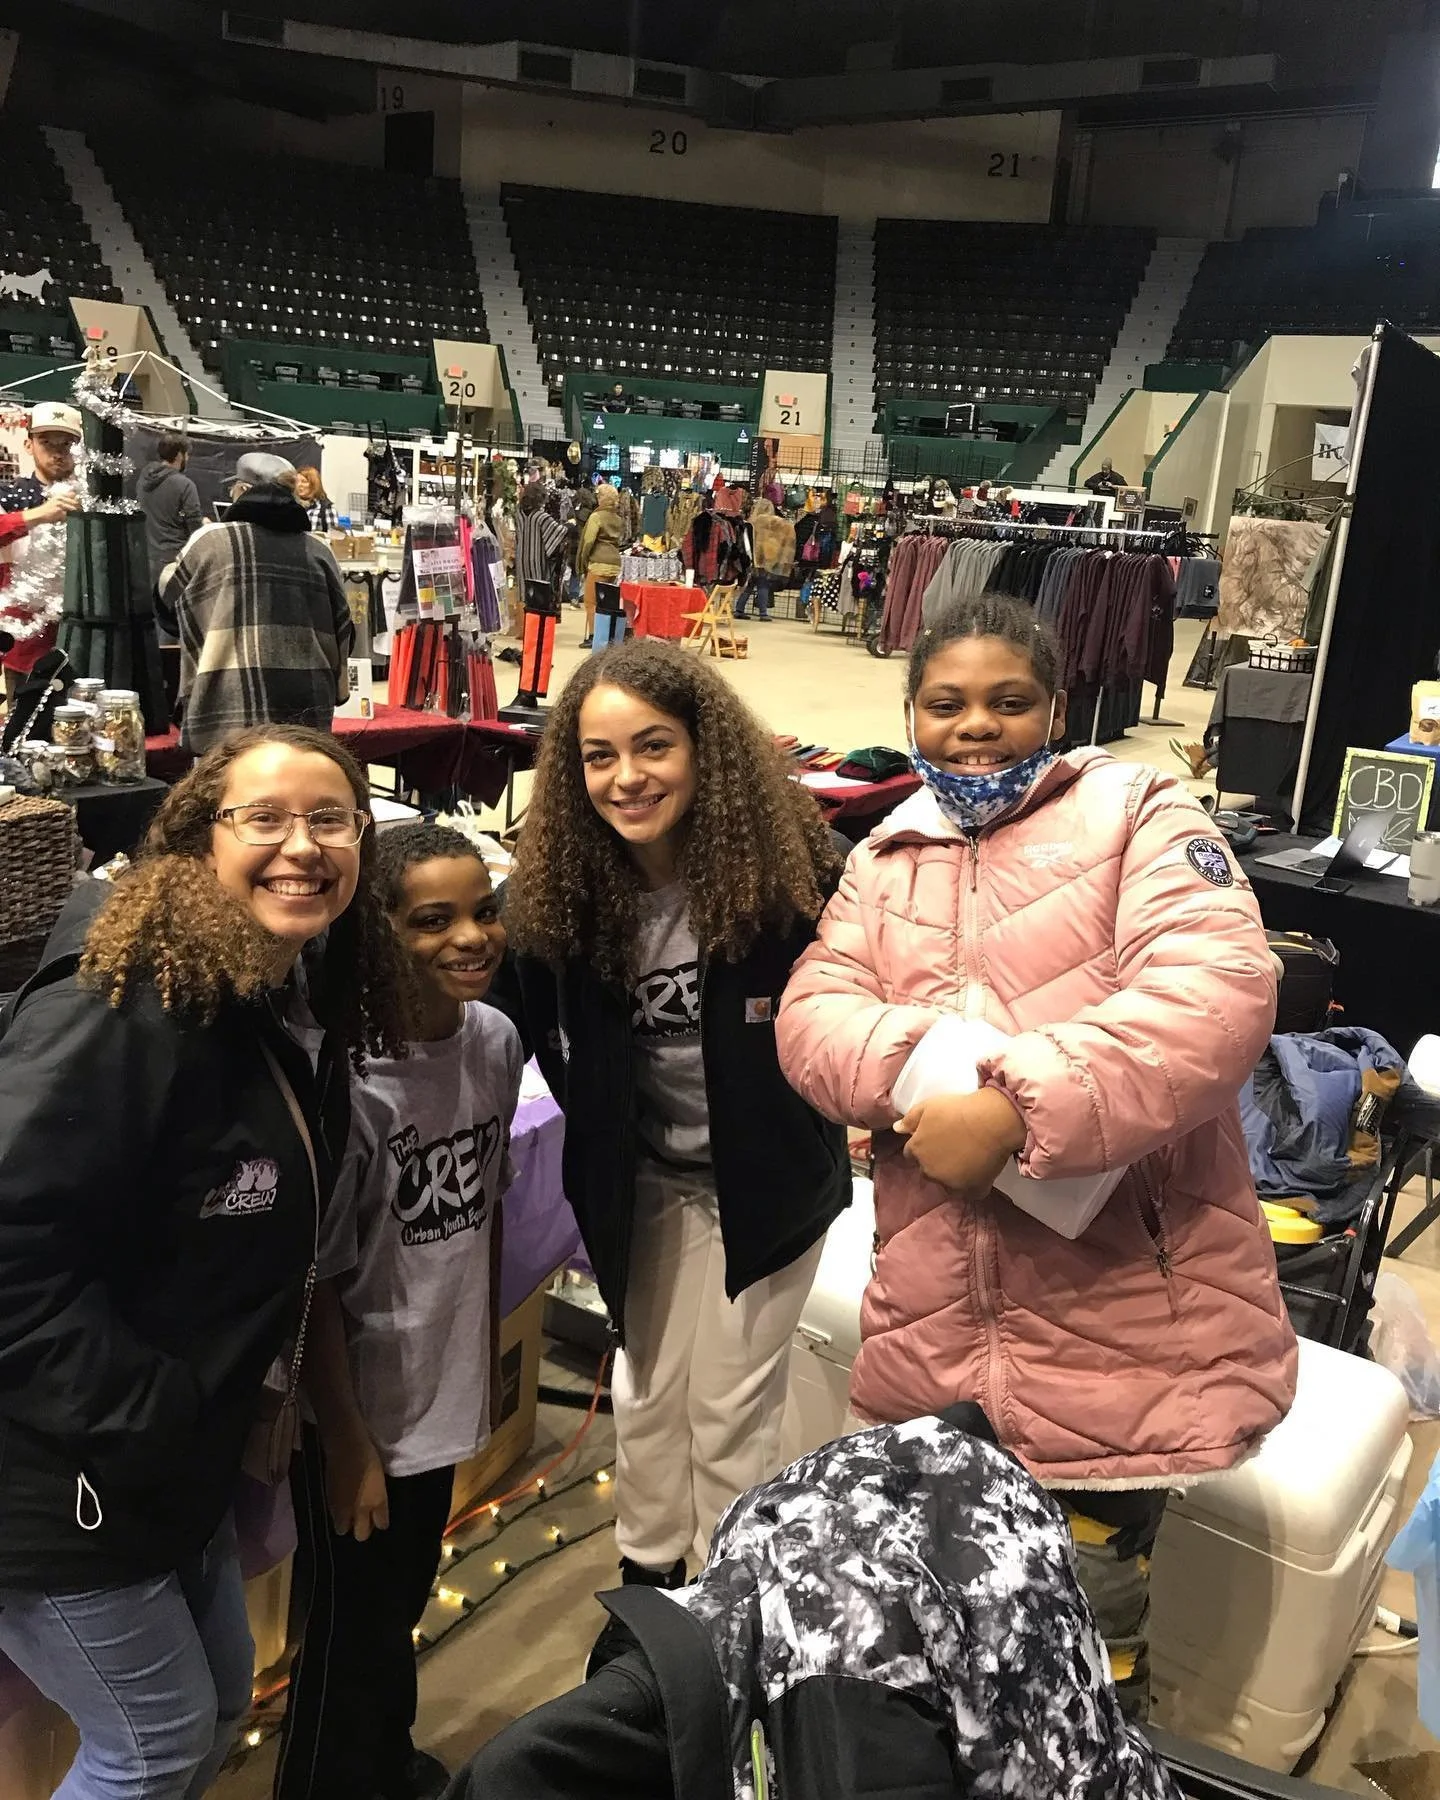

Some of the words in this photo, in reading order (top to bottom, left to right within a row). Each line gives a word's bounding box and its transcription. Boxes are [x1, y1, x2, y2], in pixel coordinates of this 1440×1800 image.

[380, 86, 404, 111] 19
[649, 129, 687, 155] 20
[988, 153, 1019, 177] 21
[450, 381, 476, 398] 20
[780, 410, 801, 426] 21
[1347, 765, 1423, 811] CBD
[632, 967, 701, 1029] RE
[225, 1187, 277, 1210] CREW
[404, 1227, 441, 1244] Urban
[443, 1214, 467, 1239] Youth
